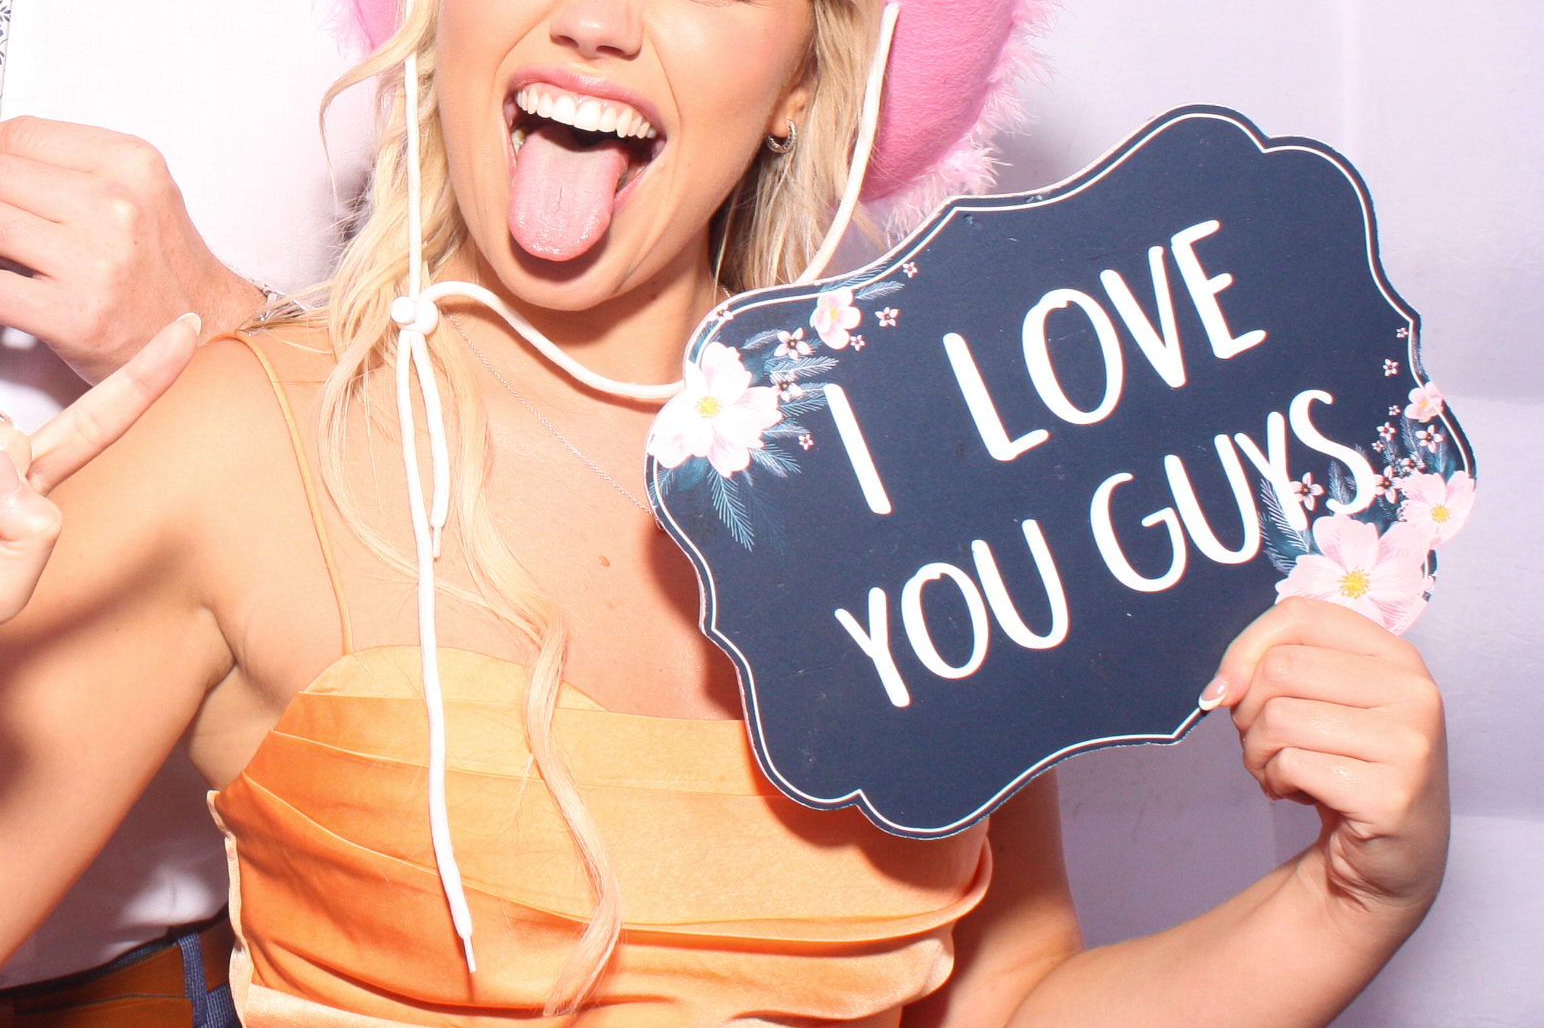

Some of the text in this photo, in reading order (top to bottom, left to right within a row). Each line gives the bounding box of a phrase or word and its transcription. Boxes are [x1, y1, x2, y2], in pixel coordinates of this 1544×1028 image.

[823, 219, 1268, 516] I LOVE
[833, 389, 1377, 709] YOU GUYS
